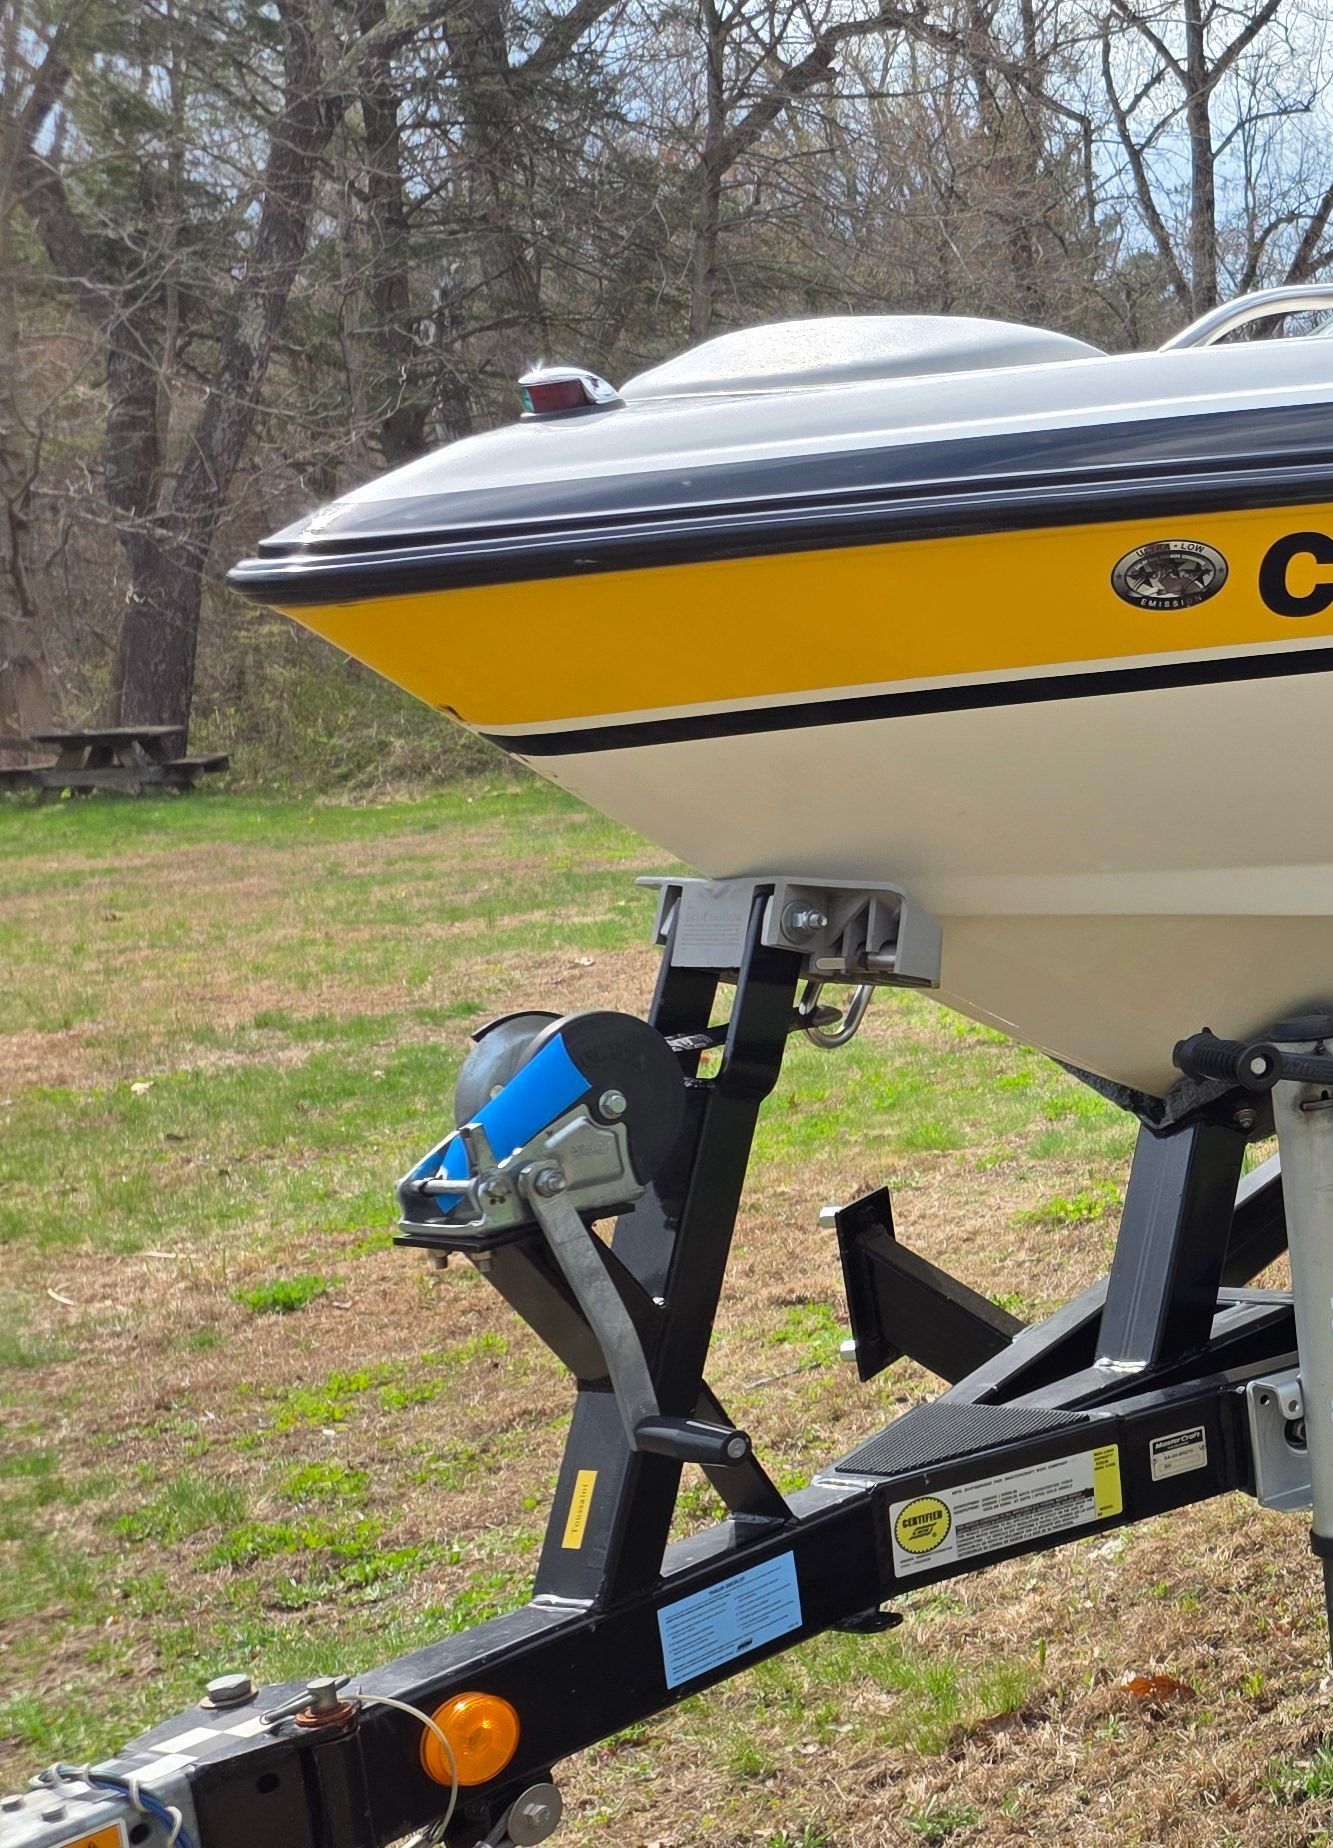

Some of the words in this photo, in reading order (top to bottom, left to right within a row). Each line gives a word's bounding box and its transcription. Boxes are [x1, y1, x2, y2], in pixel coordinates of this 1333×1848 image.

[1180, 542, 1206, 553] LOW
[1140, 597, 1202, 608] EMISSION
[902, 1509, 943, 1529] CERTIFIED
